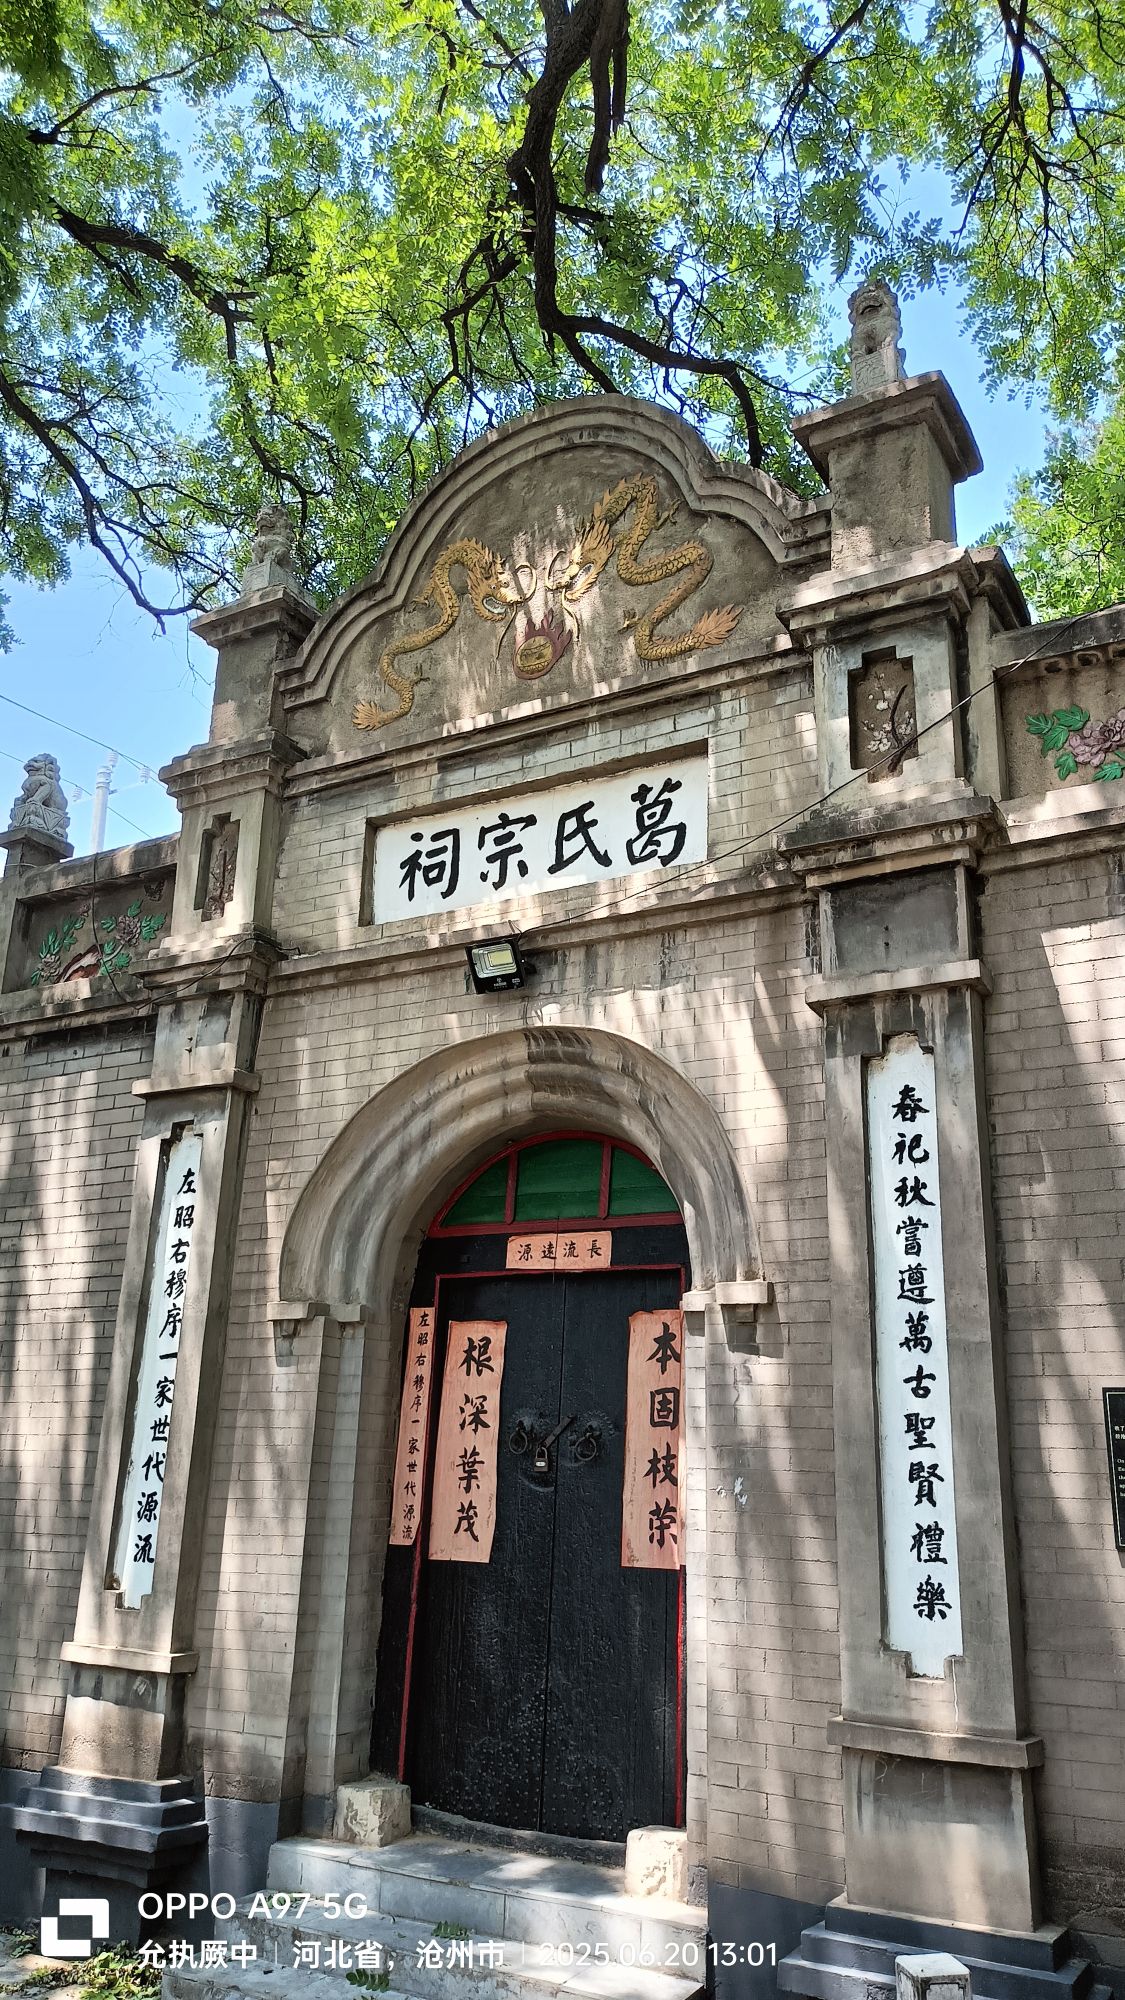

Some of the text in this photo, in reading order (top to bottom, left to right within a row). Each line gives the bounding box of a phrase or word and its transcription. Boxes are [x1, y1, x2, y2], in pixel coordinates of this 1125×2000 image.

[399, 777, 687, 902] 葛氏宗祠
[453, 1336, 495, 1543] 根深葉茂
